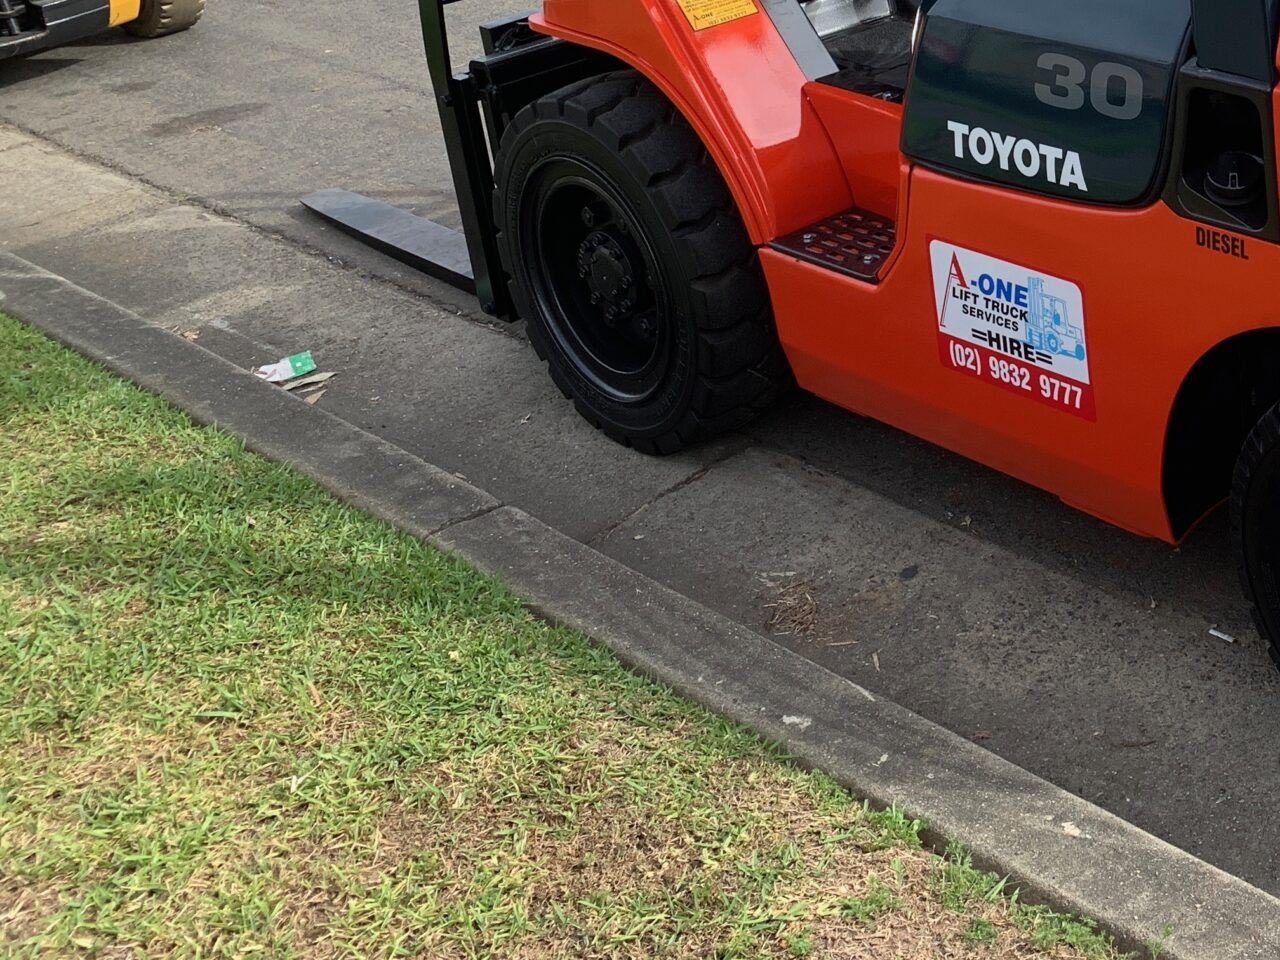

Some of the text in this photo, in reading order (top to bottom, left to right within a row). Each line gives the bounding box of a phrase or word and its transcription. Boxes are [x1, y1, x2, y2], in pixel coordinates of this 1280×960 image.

[1034, 53, 1143, 120] 30
[947, 120, 1088, 191] TOYOTA
[1195, 226, 1249, 260] DIESEL
[952, 287, 1029, 323] LIFT TRUCK
[962, 304, 1019, 332] SERVICES
[950, 340, 1082, 409] (02) 9832 9777
